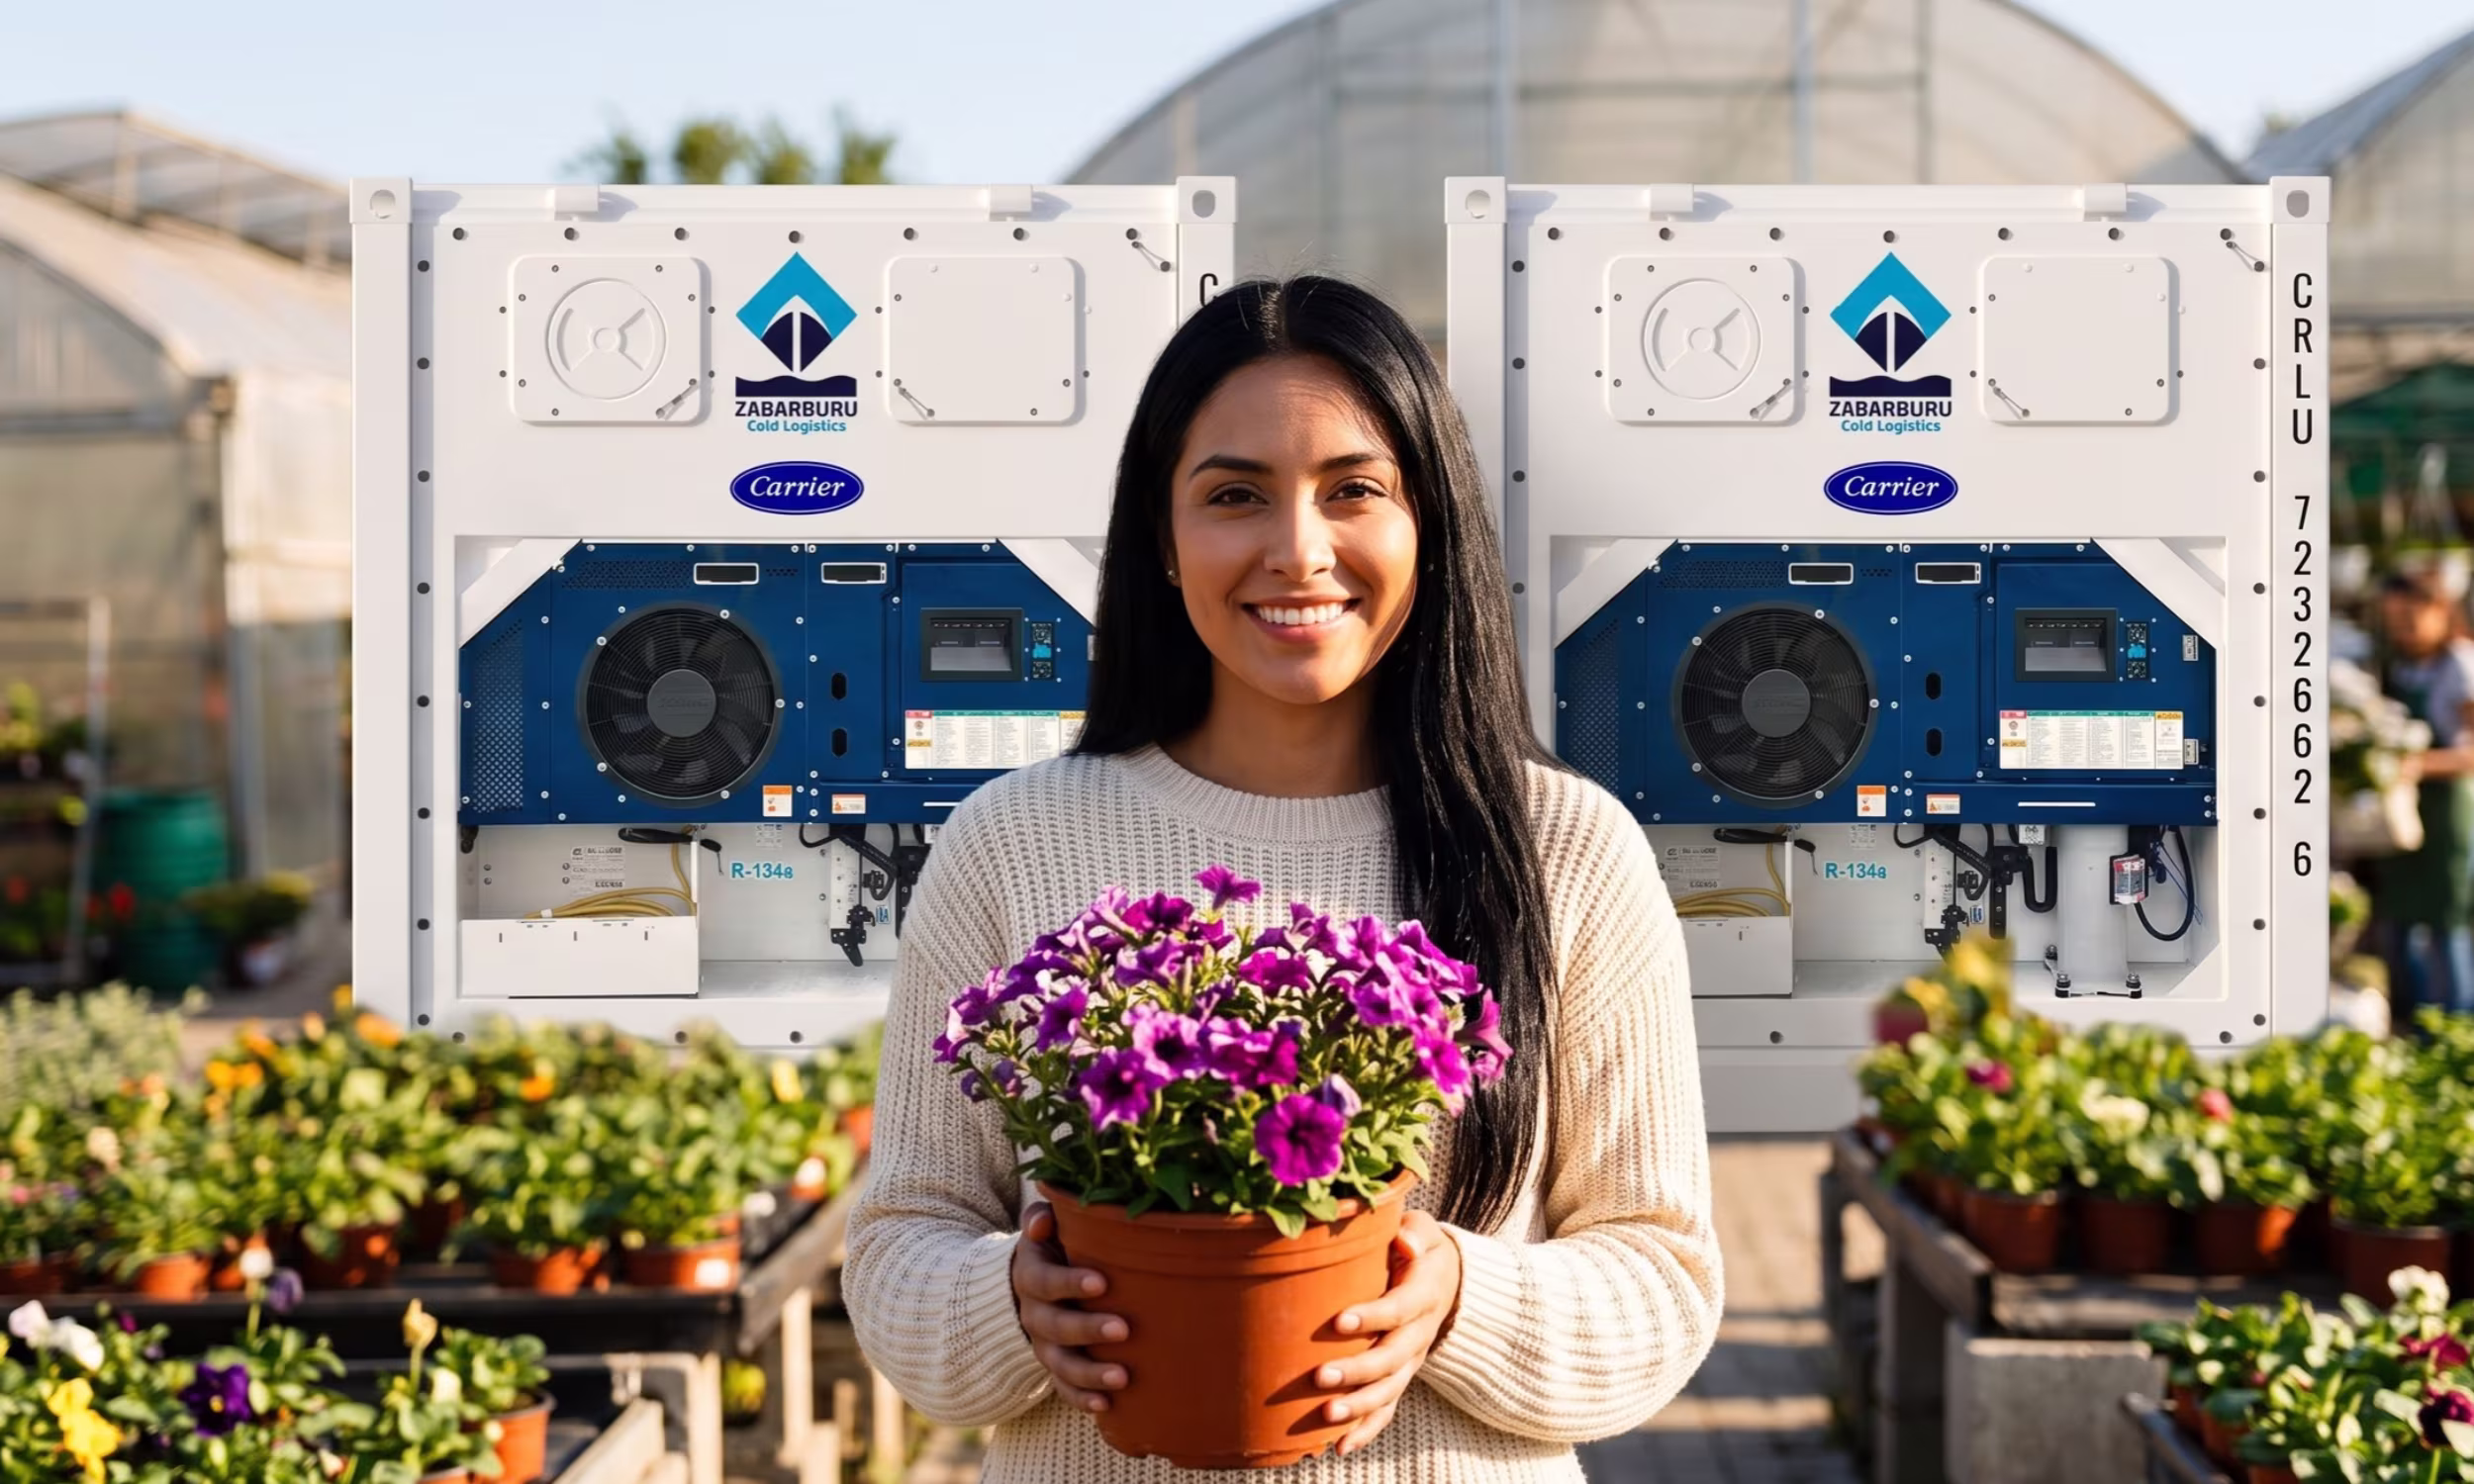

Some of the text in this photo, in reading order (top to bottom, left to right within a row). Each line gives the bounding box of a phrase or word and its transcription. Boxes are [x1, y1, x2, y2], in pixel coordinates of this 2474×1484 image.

[735, 401, 857, 417] ZABARBURU
[1829, 401, 1951, 417] ZABARBURU
[747, 419, 846, 434] Cold Logistics
[1842, 419, 1941, 434] Cold Logistics
[750, 476, 845, 497] Carrier
[1845, 476, 1940, 497] Carrier
[2293, 272, 2313, 877] CRLU 7232662 6
